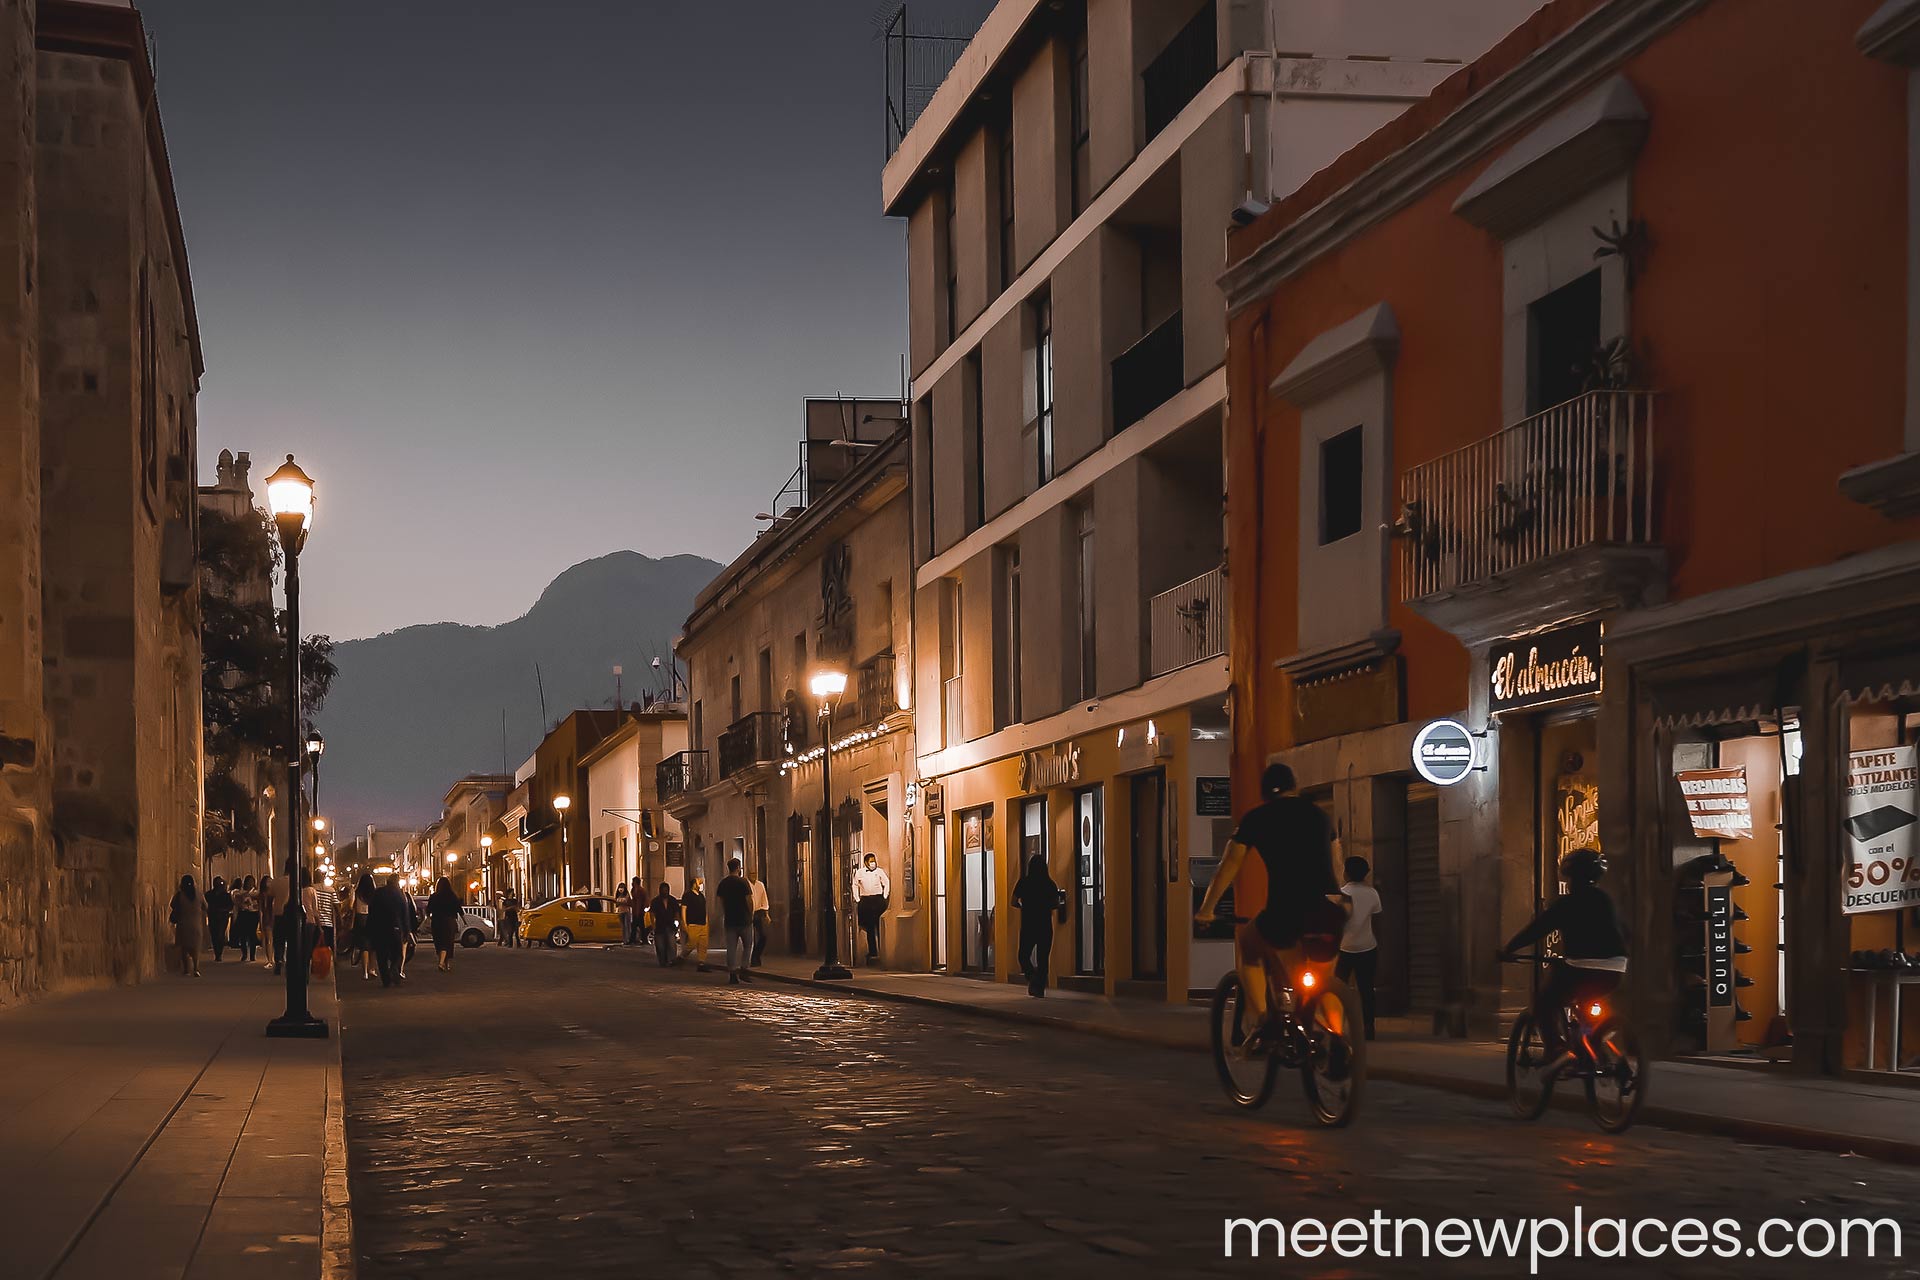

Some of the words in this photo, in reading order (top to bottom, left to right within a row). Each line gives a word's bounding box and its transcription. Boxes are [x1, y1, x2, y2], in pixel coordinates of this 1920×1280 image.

[1492, 651, 1514, 700] El
[1849, 752, 1897, 769] TAPETE
[1680, 778, 1747, 795] RECARGAS
[1869, 780, 1916, 794] MODELOS
[1868, 846, 1883, 854] con
[1885, 843, 1895, 853] el
[1848, 856, 1920, 889] 50%
[1713, 896, 1727, 995] QUIRELLI
